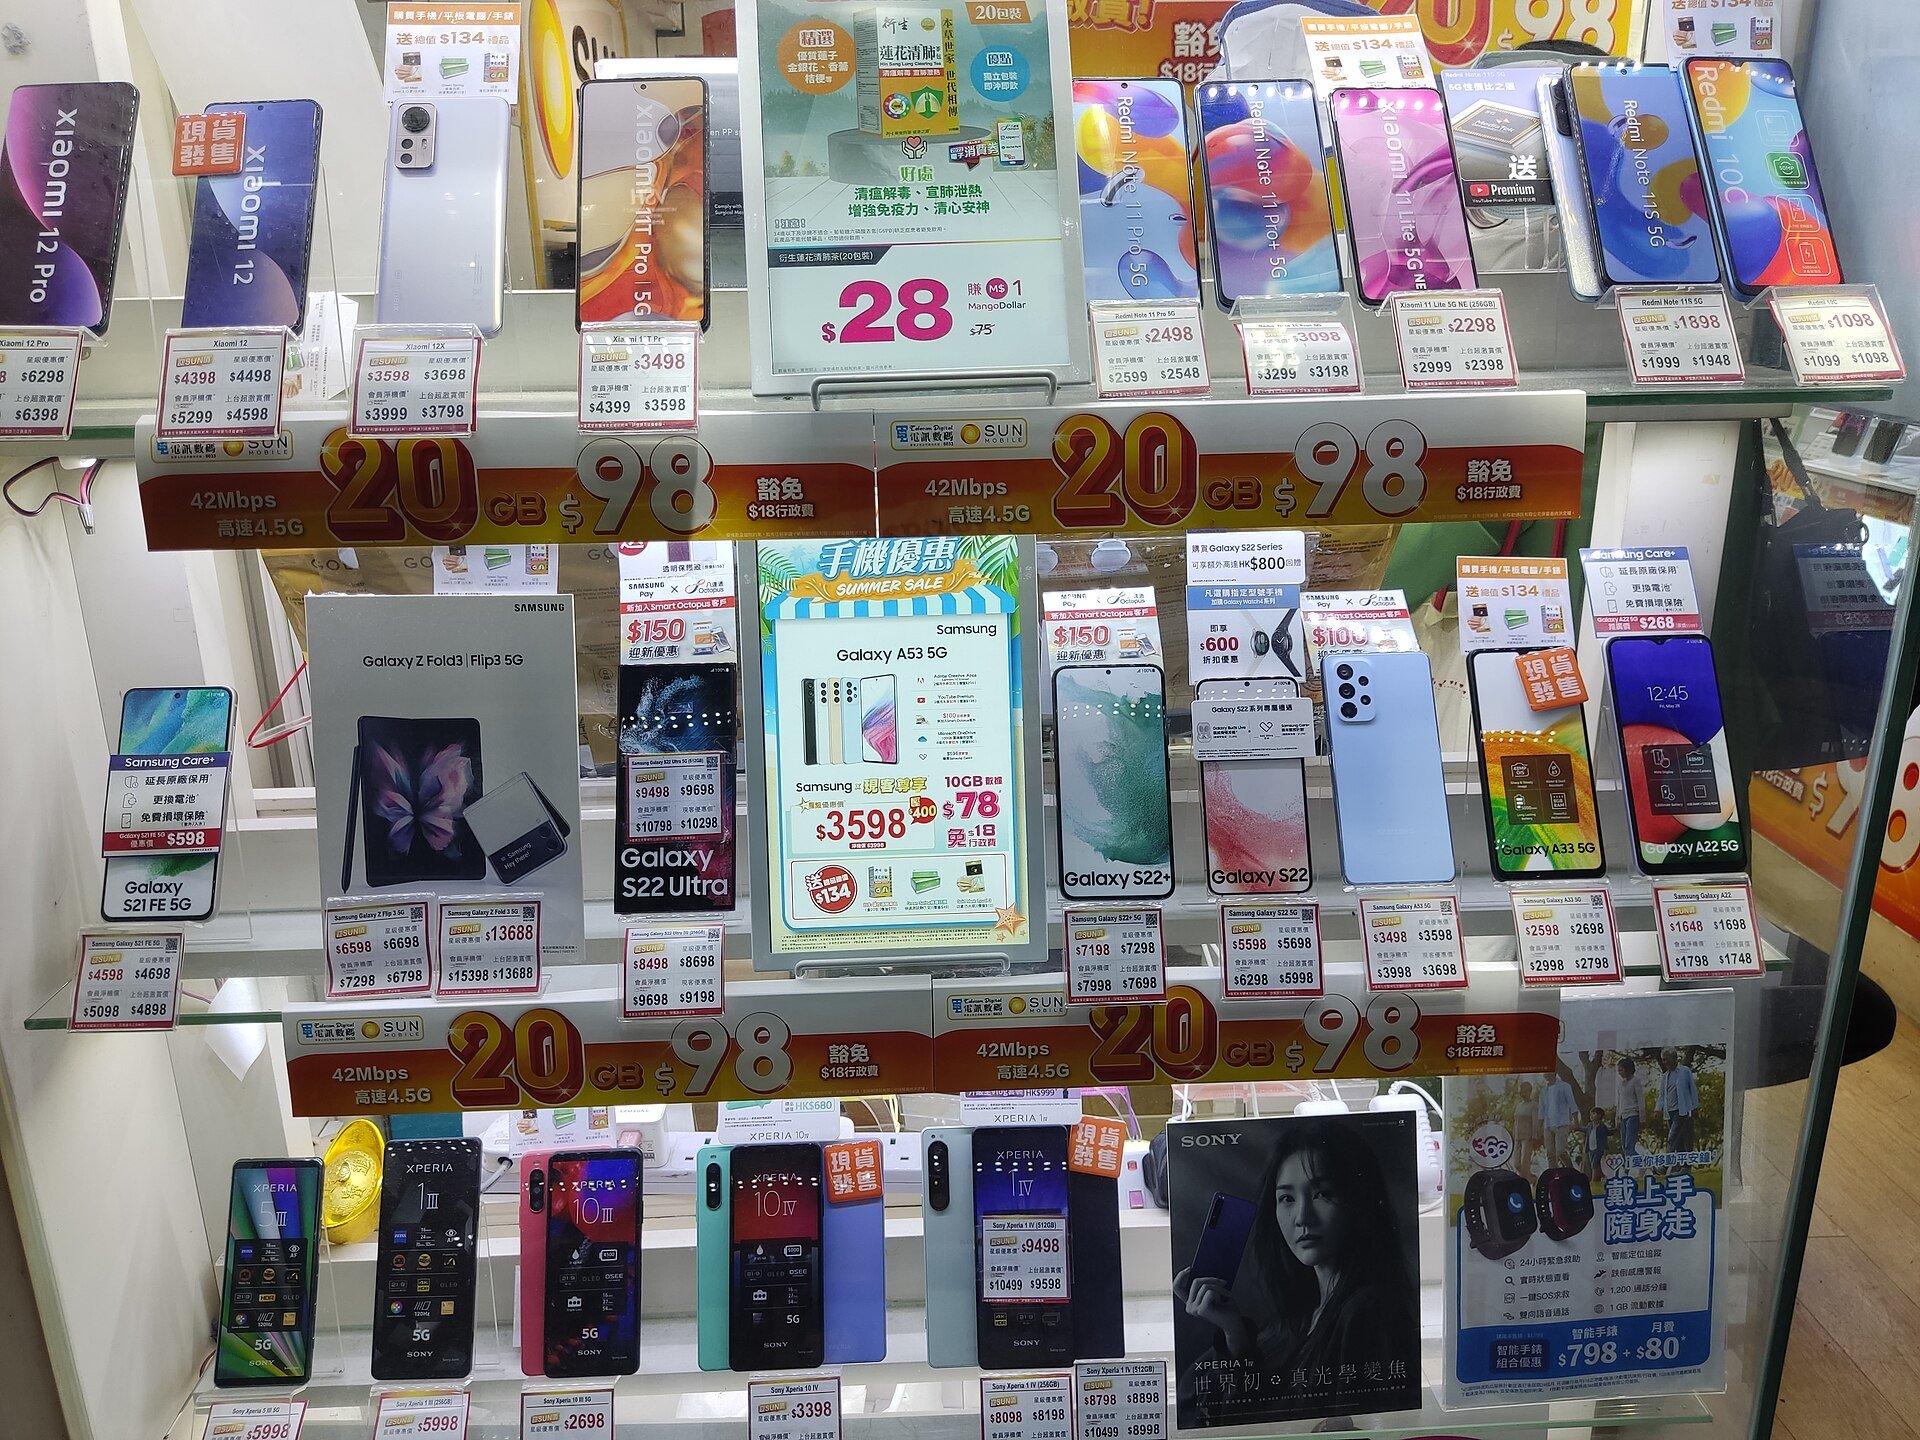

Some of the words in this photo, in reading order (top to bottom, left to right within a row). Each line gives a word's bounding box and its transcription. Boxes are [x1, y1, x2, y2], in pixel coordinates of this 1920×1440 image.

[974, 5, 1022, 20] 20包裝
[1117, 96, 1136, 144] Redmi
[1250, 100, 1269, 142] Redmi
[1624, 100, 1644, 142] Redmi
[1380, 101, 1408, 179] Xiaomi
[1695, 67, 1733, 140] Redmi
[1717, 154, 1748, 204] 10C
[635, 104, 656, 194] Xiaomi
[42, 108, 78, 217] Xiaomi
[1255, 148, 1272, 185] Note
[1633, 148, 1650, 185] Note
[1122, 152, 1137, 193] Note
[237, 145, 266, 250] Xiaomi
[1491, 184, 1535, 196] Premium
[1262, 192, 1279, 209] 11
[1396, 191, 1412, 206] 11
[1642, 192, 1659, 219] 11S
[849, 202, 990, 217] 增強免疫力、清心安神
[1126, 201, 1143, 220] 11
[635, 208, 652, 235] 11T
[1398, 209, 1415, 241] Lite
[37, 227, 59, 254] 12
[1128, 226, 1144, 255] Pro
[1264, 215, 1280, 250] Pro+
[1648, 226, 1665, 247] 5G
[634, 243, 652, 274] Pro
[1404, 248, 1423, 270] 5G
[233, 260, 254, 285] 12
[1130, 263, 1148, 286] 5G
[1270, 257, 1287, 279] 5G
[30, 264, 56, 303] Pro
[1414, 274, 1427, 290] NE
[634, 291, 651, 316] 5G
[821, 278, 953, 344] $28
[968, 300, 1026, 311] MangoDollar
[1145, 326, 1194, 343] $2498
[634, 354, 685, 369] $3498
[1642, 357, 1680, 368] $1999
[1693, 354, 1731, 366] $1948
[1852, 352, 1889, 364] $1098
[424, 369, 466, 380] $3698
[1160, 367, 1200, 379] $2548
[1310, 365, 1349, 377] $3198
[1413, 361, 1452, 373] $2999
[21, 370, 64, 383] $6298
[175, 371, 216, 385] $4398
[368, 371, 410, 381] $3598
[15, 408, 59, 420] $6398
[1467, 459, 1512, 483] 豁免
[757, 477, 803, 501] 豁免
[925, 480, 1008, 498] 42Mbps
[1457, 484, 1521, 500] $18行政費
[191, 491, 277, 510] 42Mbps
[749, 504, 815, 519] $18行政費
[948, 505, 1030, 524] 高速4.5G
[217, 518, 304, 537] 高速4.5G
[818, 536, 959, 581] 手機優惠
[836, 579, 897, 596] SUMMER
[903, 576, 943, 591] SALE
[514, 602, 565, 612] SAMSUNG
[627, 618, 685, 644] $150
[937, 623, 997, 637] Samsung
[1640, 617, 1674, 630] $268
[1054, 626, 1110, 647] $150
[1200, 637, 1239, 651] $600
[629, 646, 679, 659] 迎新優惠
[837, 649, 892, 663] Galaxy
[897, 648, 923, 659] A53
[927, 647, 947, 659] 5G
[1203, 655, 1238, 664] 折扣優惠
[363, 655, 414, 670] Galaxy
[416, 655, 424, 667] Z
[426, 653, 463, 667] Fold3
[470, 653, 501, 669] Flip3
[505, 653, 524, 667] 5G
[1647, 685, 1689, 701] 12:45
[125, 758, 180, 768] Samsung
[182, 757, 215, 765] Care+
[636, 786, 669, 798] $9498
[680, 784, 714, 796] $9698
[943, 792, 1000, 819] $78
[817, 809, 906, 840] $3598
[167, 832, 205, 846] $598
[1502, 842, 1549, 858] Galaxy
[1552, 841, 1575, 854] A33
[1577, 841, 1595, 853] 5G
[1645, 842, 1695, 856] Galaxy
[1696, 840, 1719, 852] A22
[1720, 839, 1738, 851] 5G
[621, 847, 714, 871] Galaxy
[1065, 872, 1130, 889] Galaxy
[1133, 870, 1170, 885] S22+
[1212, 870, 1275, 887] Galaxy
[1279, 868, 1308, 882] S22
[125, 881, 183, 896] Galaxy
[622, 877, 664, 897] S22
[669, 876, 728, 896] Ultra
[123, 899, 146, 911] S21
[150, 899, 166, 911] FE
[170, 898, 191, 910] 5G
[1526, 924, 1559, 936] $2598
[1570, 923, 1604, 934] $2698
[1714, 919, 1746, 930] $1698
[384, 936, 419, 950] $6698
[1278, 937, 1311, 949] $5698
[1419, 929, 1452, 941] $3598
[336, 941, 372, 954] $6598
[1121, 942, 1155, 954] $7298
[1233, 939, 1266, 950] $5598
[634, 958, 668, 970] $8498
[680, 955, 714, 967] $8698
[135, 968, 171, 979] $4698
[493, 967, 533, 980] $13688
[1456, 1024, 1496, 1043] 豁免
[829, 1044, 870, 1063] 豁免
[976, 1042, 1050, 1058] 42Mbps
[1447, 1045, 1504, 1058] $18行政費
[332, 1066, 409, 1084] 42Mbps
[820, 1065, 879, 1079] $18行政費
[997, 1064, 1070, 1080] 高速4.5G
[355, 1087, 431, 1105] 高速4.5G
[795, 1101, 832, 1111] HK$680
[994, 1114, 1036, 1122] XPERIA
[1181, 1132, 1242, 1148] SONY
[997, 1150, 1043, 1160] XPERIA
[406, 1164, 453, 1173] XPERIA
[254, 1184, 297, 1193] XPERIA
[572, 1181, 615, 1190] XPERIA
[1605, 1175, 1693, 1207] 戴上手
[1605, 1209, 1696, 1242] 隨身走
[1022, 1238, 1059, 1253] $9498
[990, 1279, 1022, 1291] $10499
[786, 1314, 800, 1324] 5G
[413, 1329, 430, 1341] 5G
[582, 1328, 598, 1339] 5G
[1572, 1326, 1618, 1339] 智能手錶
[255, 1339, 272, 1350] 5G
[1013, 1339, 1040, 1347] SONY
[1636, 1337, 1680, 1360] $80
[1558, 1342, 1617, 1367] $798
[1195, 1360, 1241, 1371] XPERIA
[1084, 1395, 1116, 1406] $8798
[1127, 1393, 1159, 1404] $8898
[791, 1402, 832, 1418] $3398
[1033, 1409, 1065, 1422] $8198
[418, 1416, 458, 1433] $5998
[564, 1413, 605, 1430] $2698
